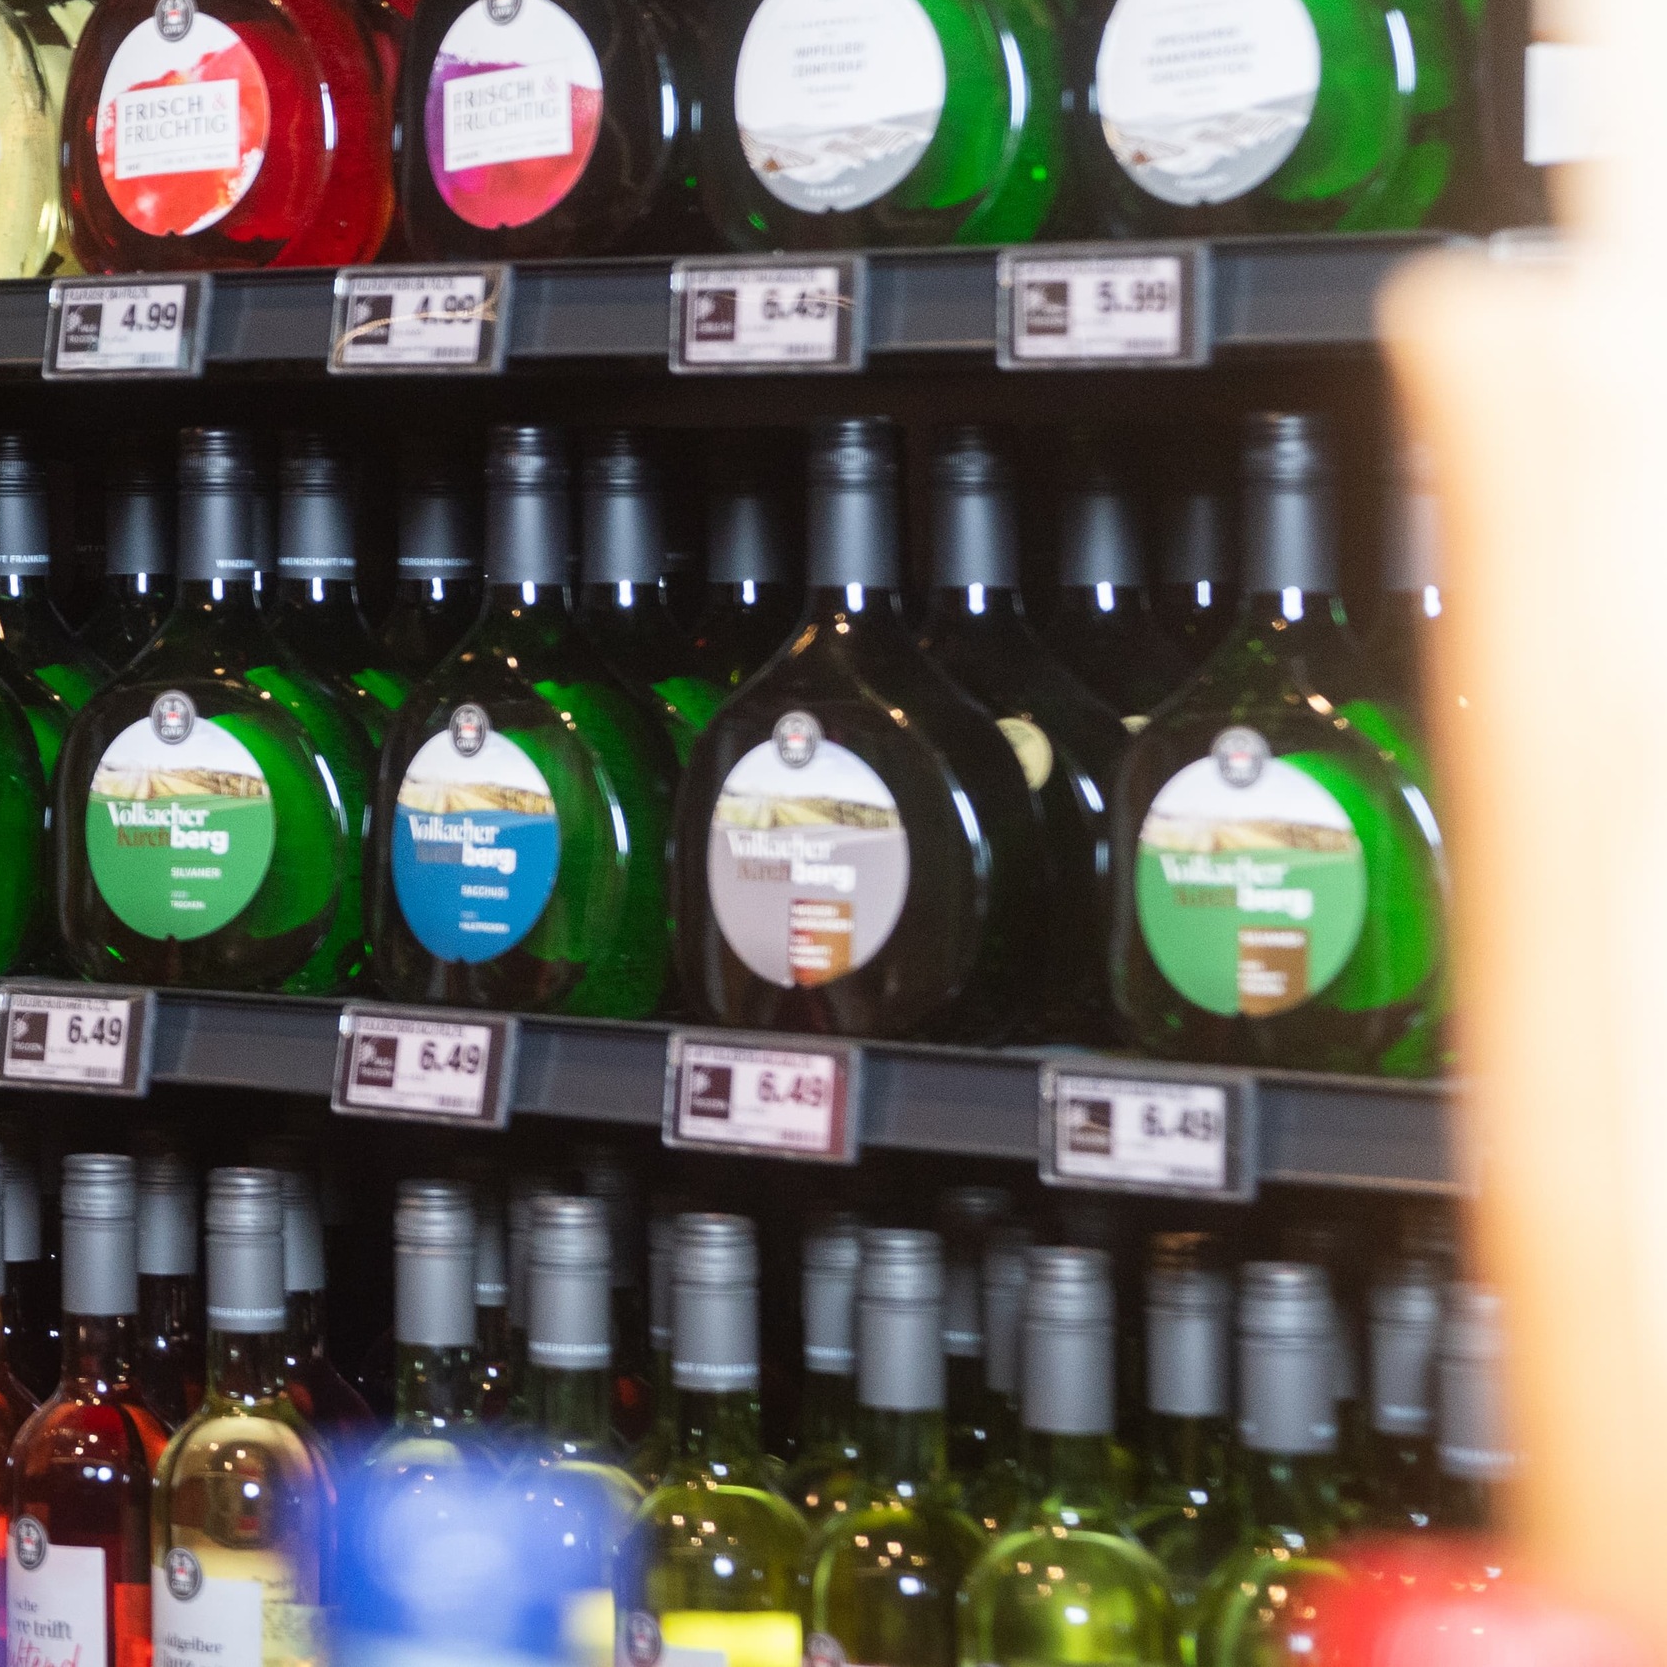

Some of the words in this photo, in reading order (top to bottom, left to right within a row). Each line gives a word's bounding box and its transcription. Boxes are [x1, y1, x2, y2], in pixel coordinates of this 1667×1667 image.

[124, 96, 204, 123] FRISCH
[452, 80, 534, 111] FRISCH
[124, 116, 228, 147] FRUCHTIG
[452, 100, 562, 134] FRUCHTIG
[120, 301, 178, 331] 4.99
[417, 294, 476, 328] 4.99
[106, 801, 210, 827] Volkacher
[408, 814, 500, 845] Volkacher
[726, 831, 837, 861] Volkacher
[170, 866, 221, 879] SILVANER
[67, 1014, 123, 1047] 6.49
[418, 1040, 482, 1074] 6.49
[756, 1071, 824, 1106] 6.49
